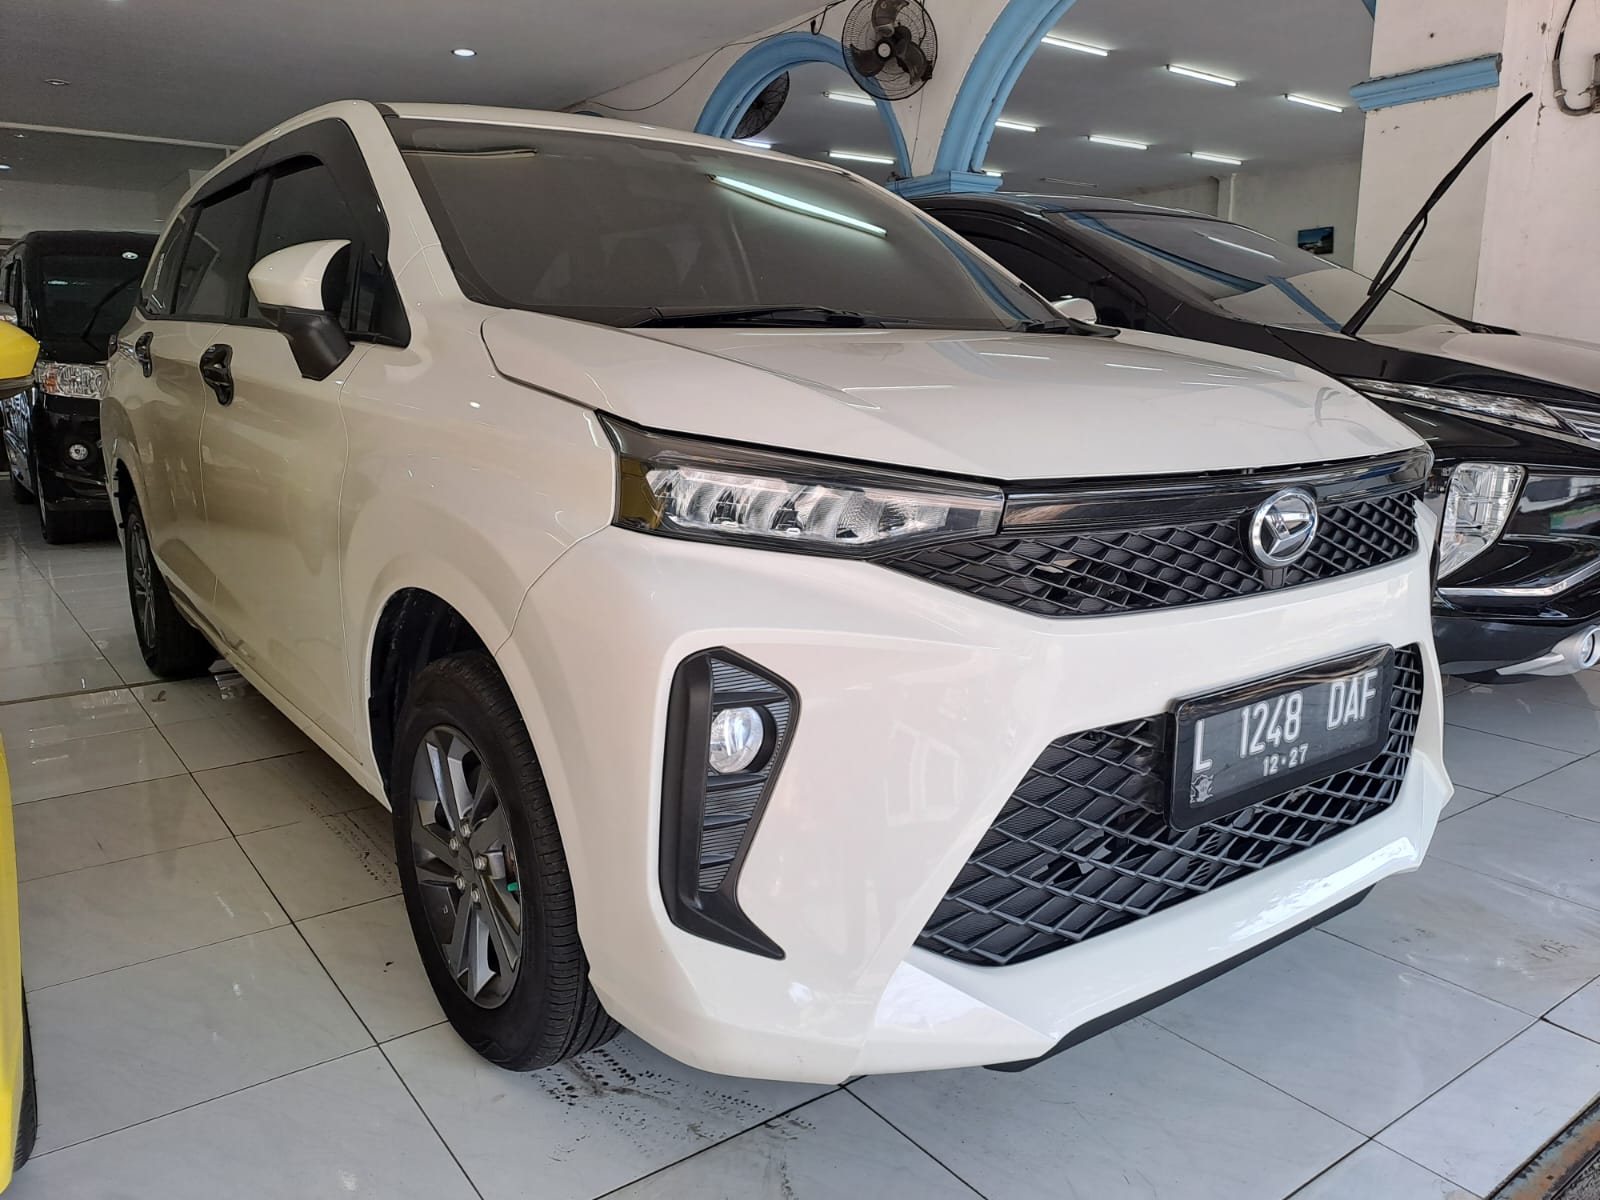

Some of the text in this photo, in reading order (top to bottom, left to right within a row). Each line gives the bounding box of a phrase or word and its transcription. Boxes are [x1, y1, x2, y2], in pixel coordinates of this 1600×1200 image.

[1194, 669, 1379, 773] L 1248 DAF
